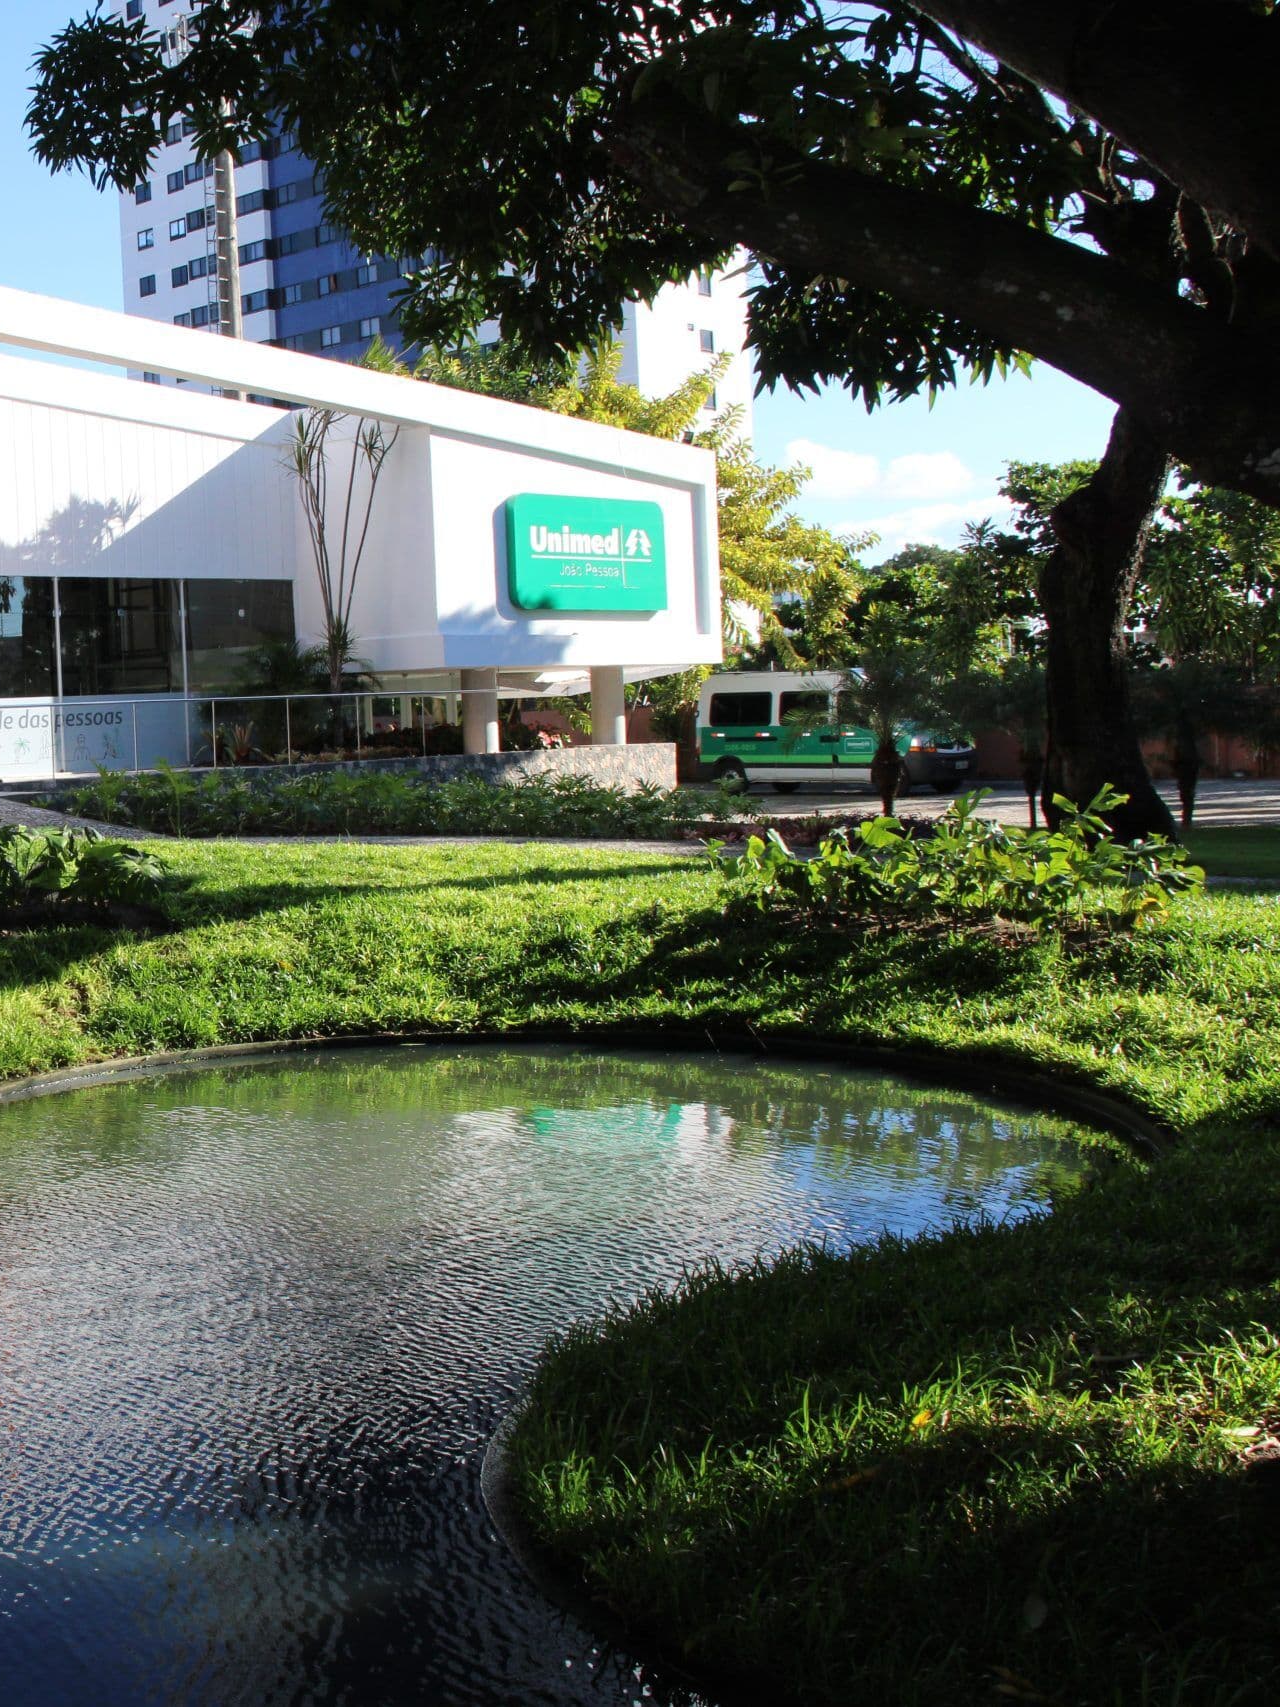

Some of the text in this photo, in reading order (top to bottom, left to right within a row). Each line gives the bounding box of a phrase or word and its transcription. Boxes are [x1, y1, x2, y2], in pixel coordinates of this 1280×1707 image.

[529, 525, 620, 555] Unimed
[585, 563, 621, 577] Pessoa
[19, 709, 49, 729] das
[54, 711, 123, 734] pessoas
